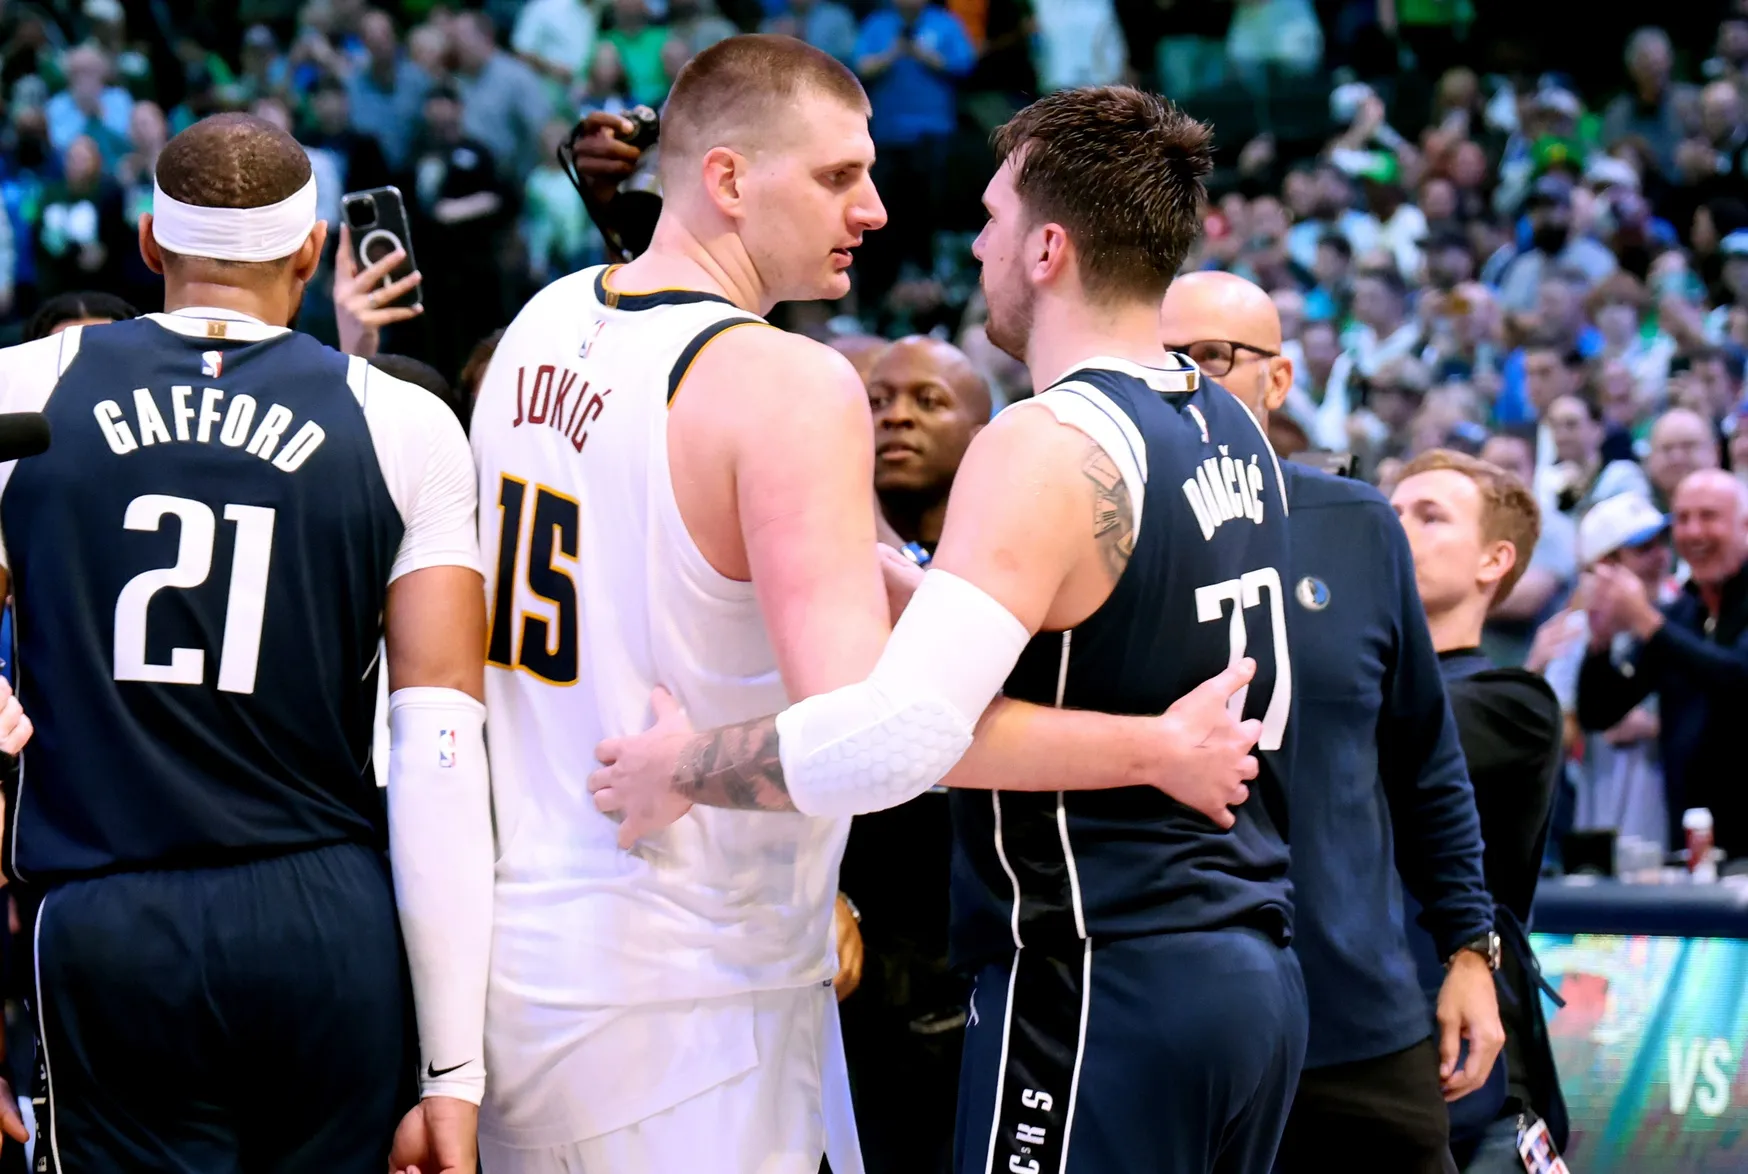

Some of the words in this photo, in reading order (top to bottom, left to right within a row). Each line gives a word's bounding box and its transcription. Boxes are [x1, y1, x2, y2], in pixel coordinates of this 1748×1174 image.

[92, 384, 326, 474] GAFFORD
[512, 364, 612, 454] JOKIĆ
[1181, 443, 1264, 541] DONČIĆ
[113, 493, 276, 695] 21
[485, 471, 580, 688] 15
[1194, 566, 1292, 751] 77
[1667, 1036, 1733, 1116] VS
